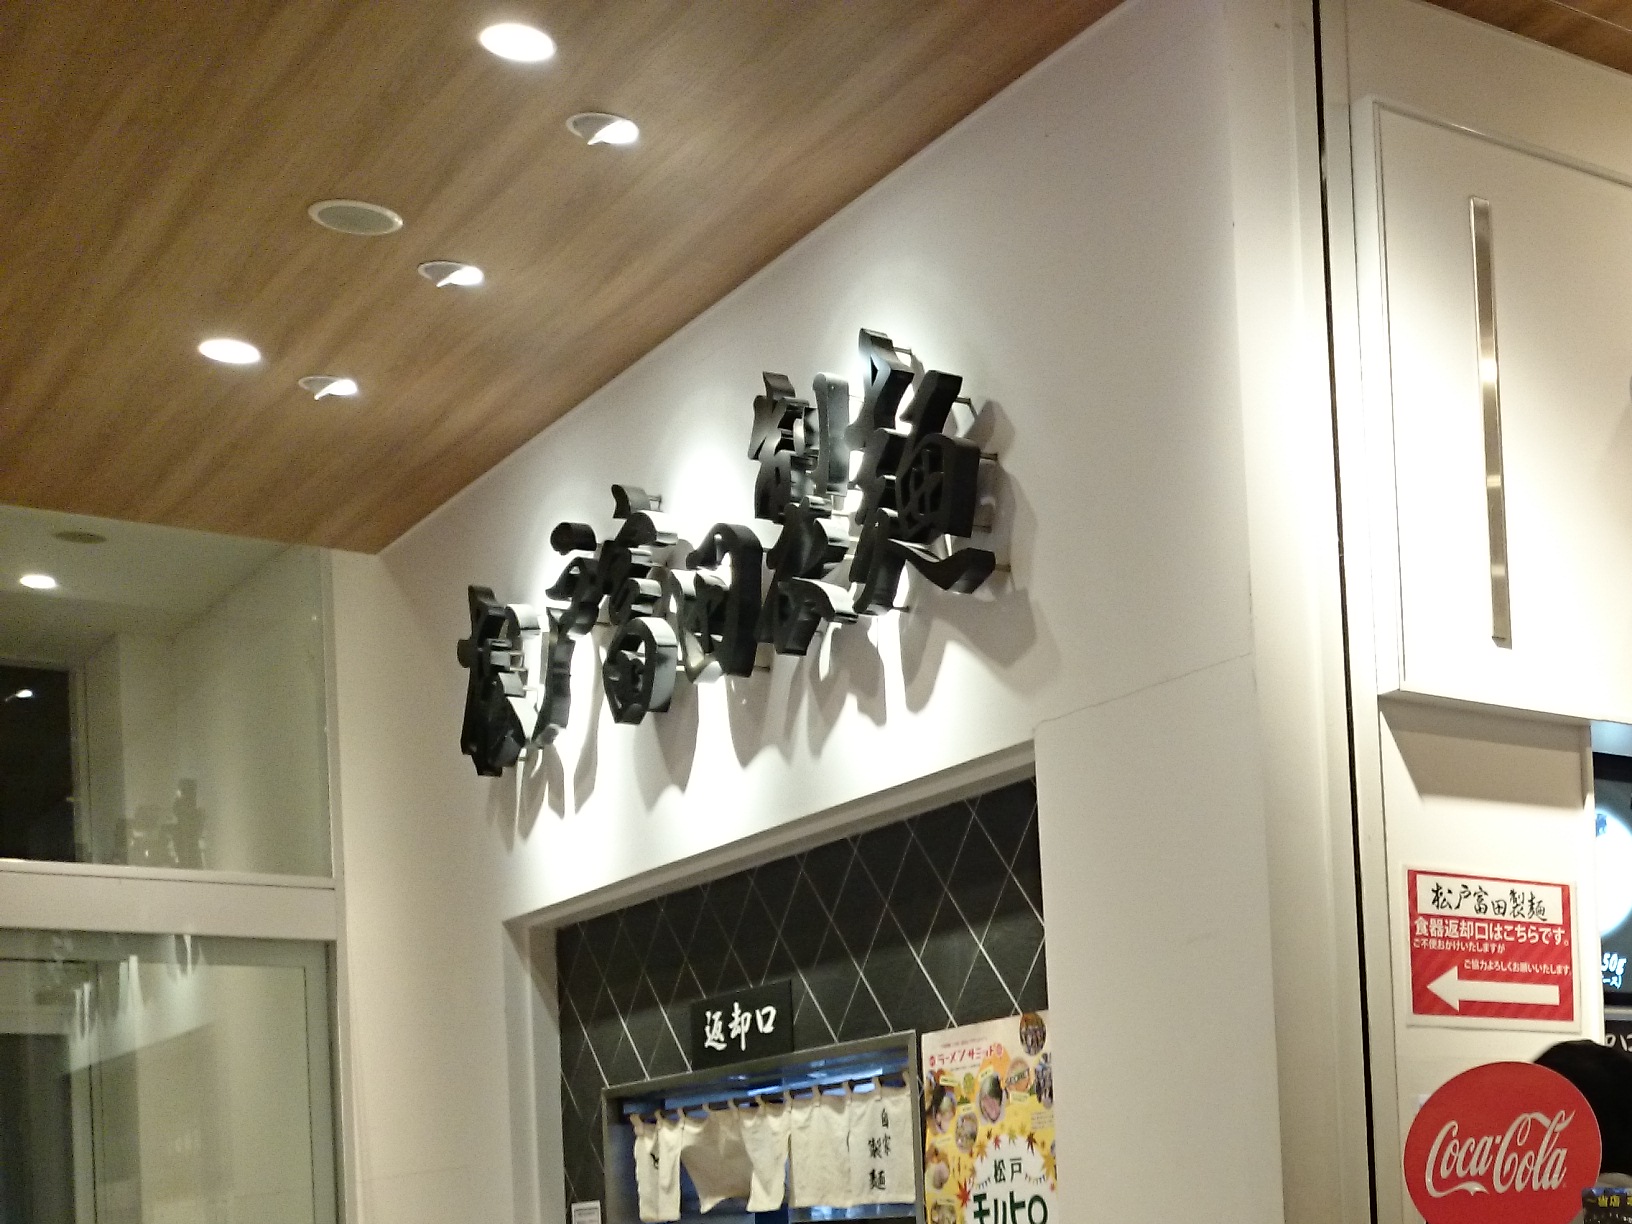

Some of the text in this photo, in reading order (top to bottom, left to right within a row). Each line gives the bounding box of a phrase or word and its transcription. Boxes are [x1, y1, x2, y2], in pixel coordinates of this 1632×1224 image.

[1431, 882, 1548, 922] 松戸富田製麺
[1413, 916, 1569, 947] 食器返却口はこちらです。
[704, 1000, 777, 1053] 返却口
[993, 1156, 1024, 1184] 松戸
[1425, 1109, 1575, 1198] Coca-Cola
